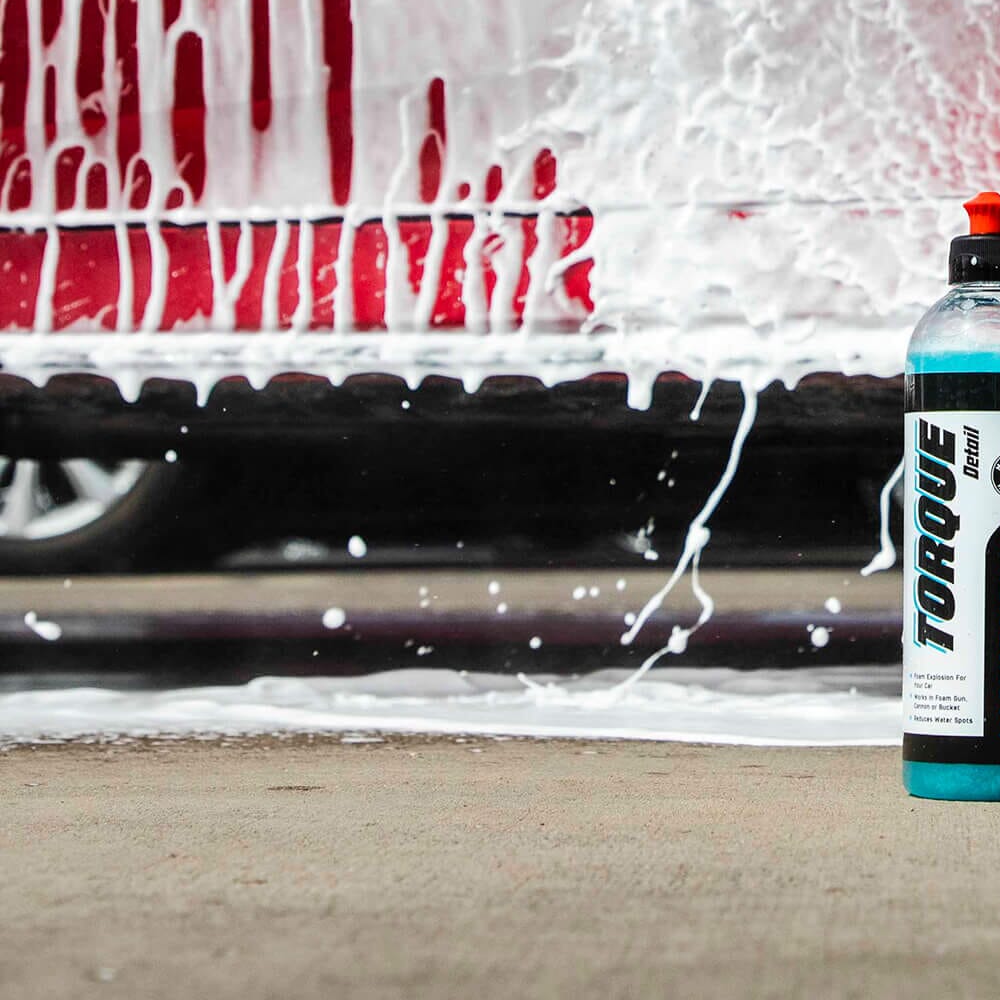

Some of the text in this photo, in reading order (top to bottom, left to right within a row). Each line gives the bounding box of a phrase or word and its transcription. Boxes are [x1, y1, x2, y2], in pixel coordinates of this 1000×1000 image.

[963, 425, 980, 480] Detail
[914, 418, 961, 653] TORQUE
[927, 673, 954, 681] Explosion
